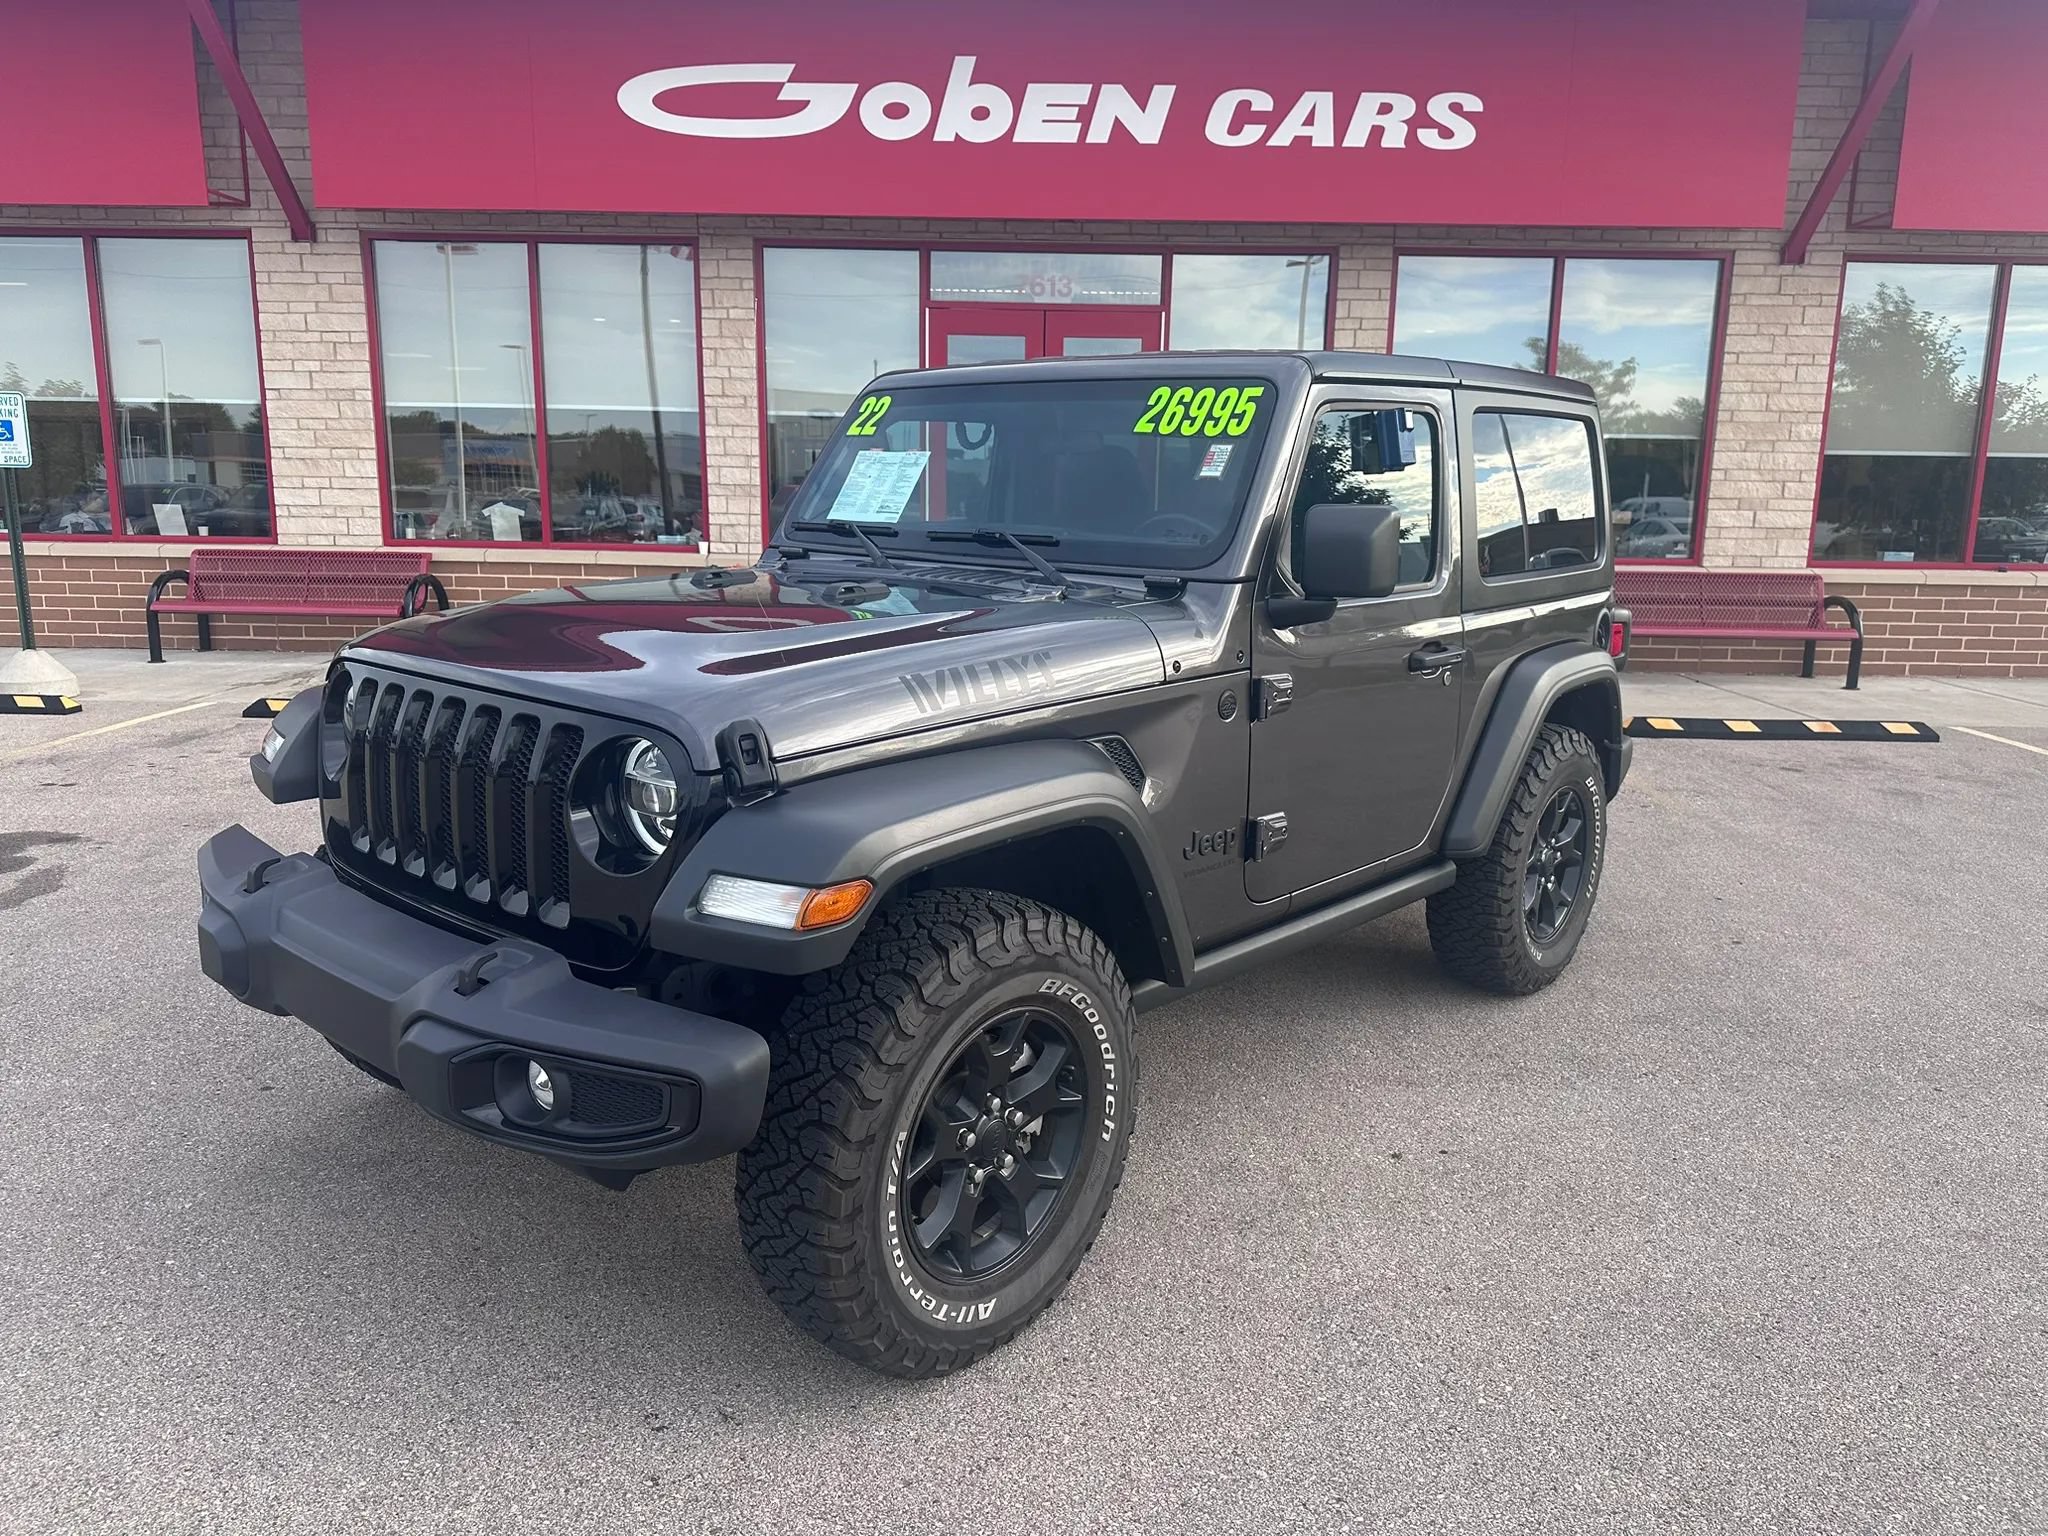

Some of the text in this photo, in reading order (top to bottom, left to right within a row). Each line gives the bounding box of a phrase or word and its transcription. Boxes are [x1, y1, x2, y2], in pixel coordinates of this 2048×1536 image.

[1203, 87, 1485, 151] CARS
[846, 395, 892, 436] 22
[1132, 385, 1265, 437] 26995
[4, 455, 27, 464] SPACE
[897, 651, 1057, 714] WILLYS
[1182, 826, 1237, 861] Jeep
[1584, 776, 1601, 900] BFGoodrich
[1038, 978, 1119, 1142] BFGoodrich
[886, 1131, 998, 1324] All-Terrain T/A
